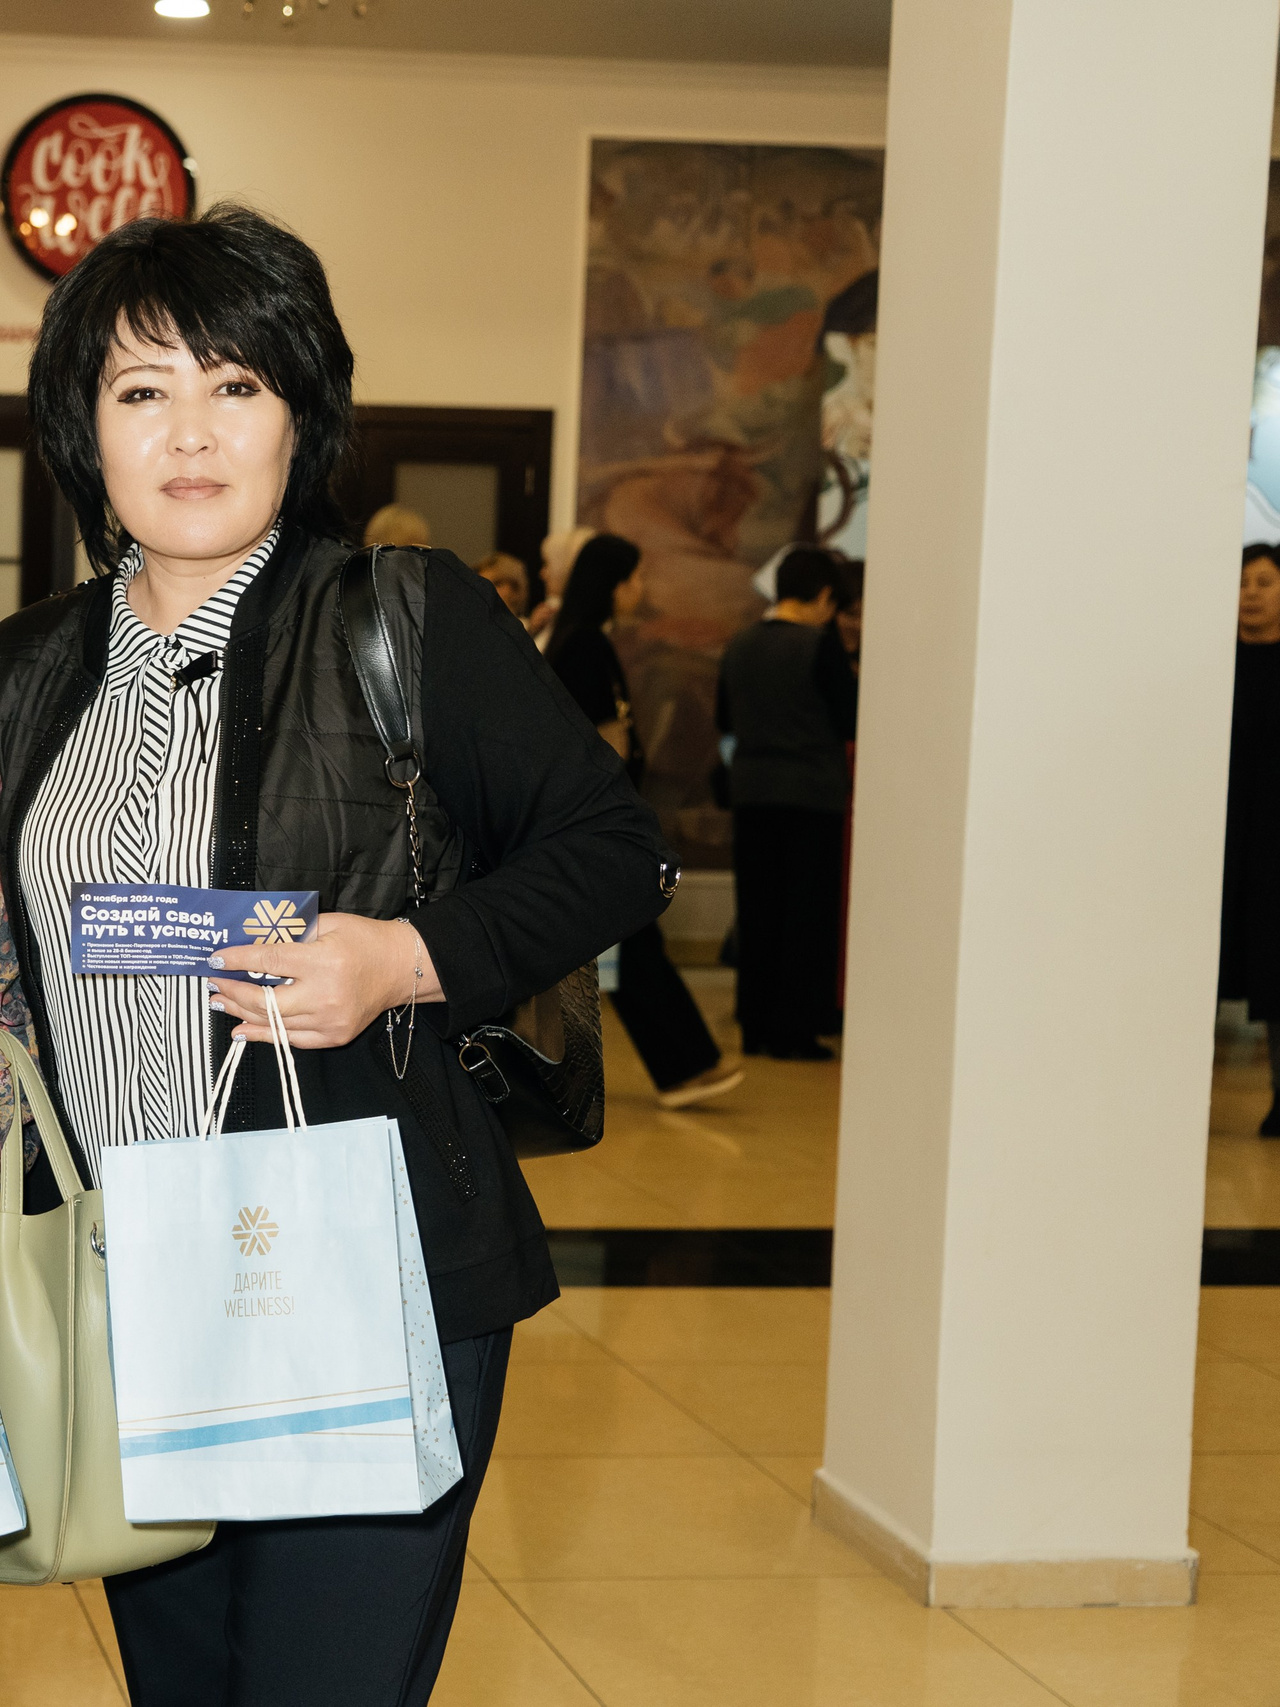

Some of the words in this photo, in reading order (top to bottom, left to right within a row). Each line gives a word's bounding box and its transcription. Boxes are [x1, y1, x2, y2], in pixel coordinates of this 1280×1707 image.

[31, 113, 169, 194] Cook
[94, 895, 128, 904] ноября
[80, 906, 160, 924] Создай
[166, 910, 215, 927] свой
[82, 924, 129, 939] путь
[134, 925, 146, 936] к
[150, 925, 228, 945] успеху!
[233, 1270, 282, 1294] ДАРИТЕ
[224, 1296, 295, 1318] WELLNESS!
